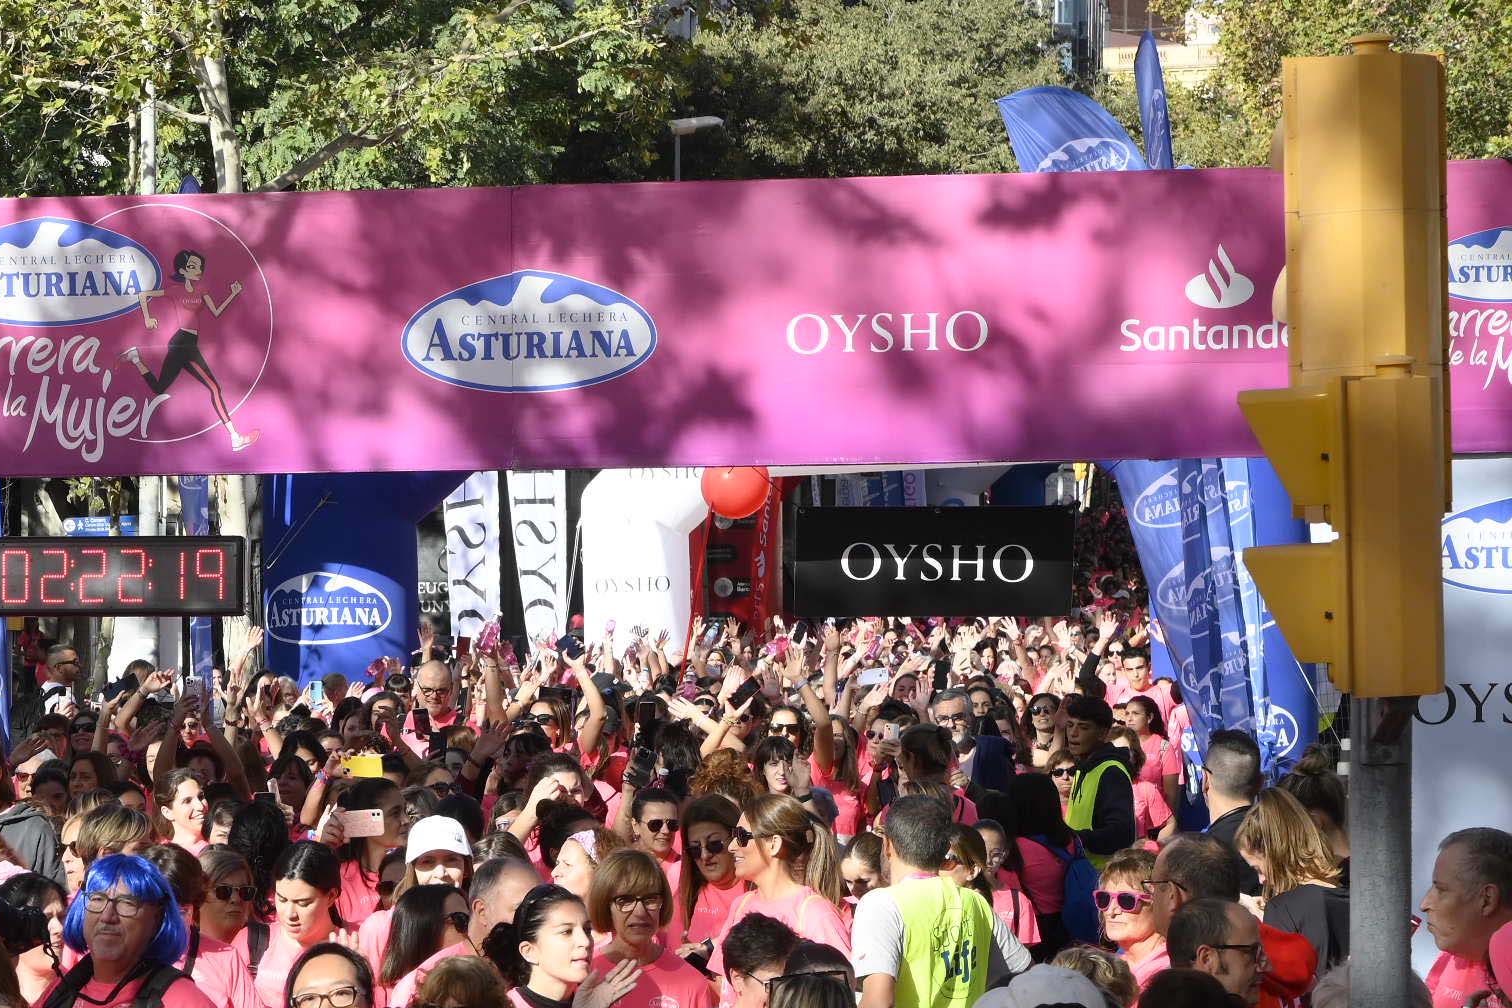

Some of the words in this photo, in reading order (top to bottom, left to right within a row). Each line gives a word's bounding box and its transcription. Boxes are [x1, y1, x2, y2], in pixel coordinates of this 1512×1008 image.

[64, 253, 137, 265] LECHERA
[461, 314, 540, 326] CENTRAL
[547, 311, 631, 323] LECHERA
[1448, 308, 1512, 338] arre
[421, 318, 637, 362] ASTURIANA
[787, 311, 989, 356] OYSHO
[1469, 337, 1488, 366] la
[2, 389, 27, 417] la
[21, 369, 170, 463] Mujer
[0, 548, 225, 604] 02:22:19
[840, 541, 1035, 583] OYSHO
[595, 575, 672, 593] OYSHO
[282, 595, 325, 605] CENTRAL
[327, 595, 378, 605] LECHERA
[269, 602, 382, 628] ASTURIANA
